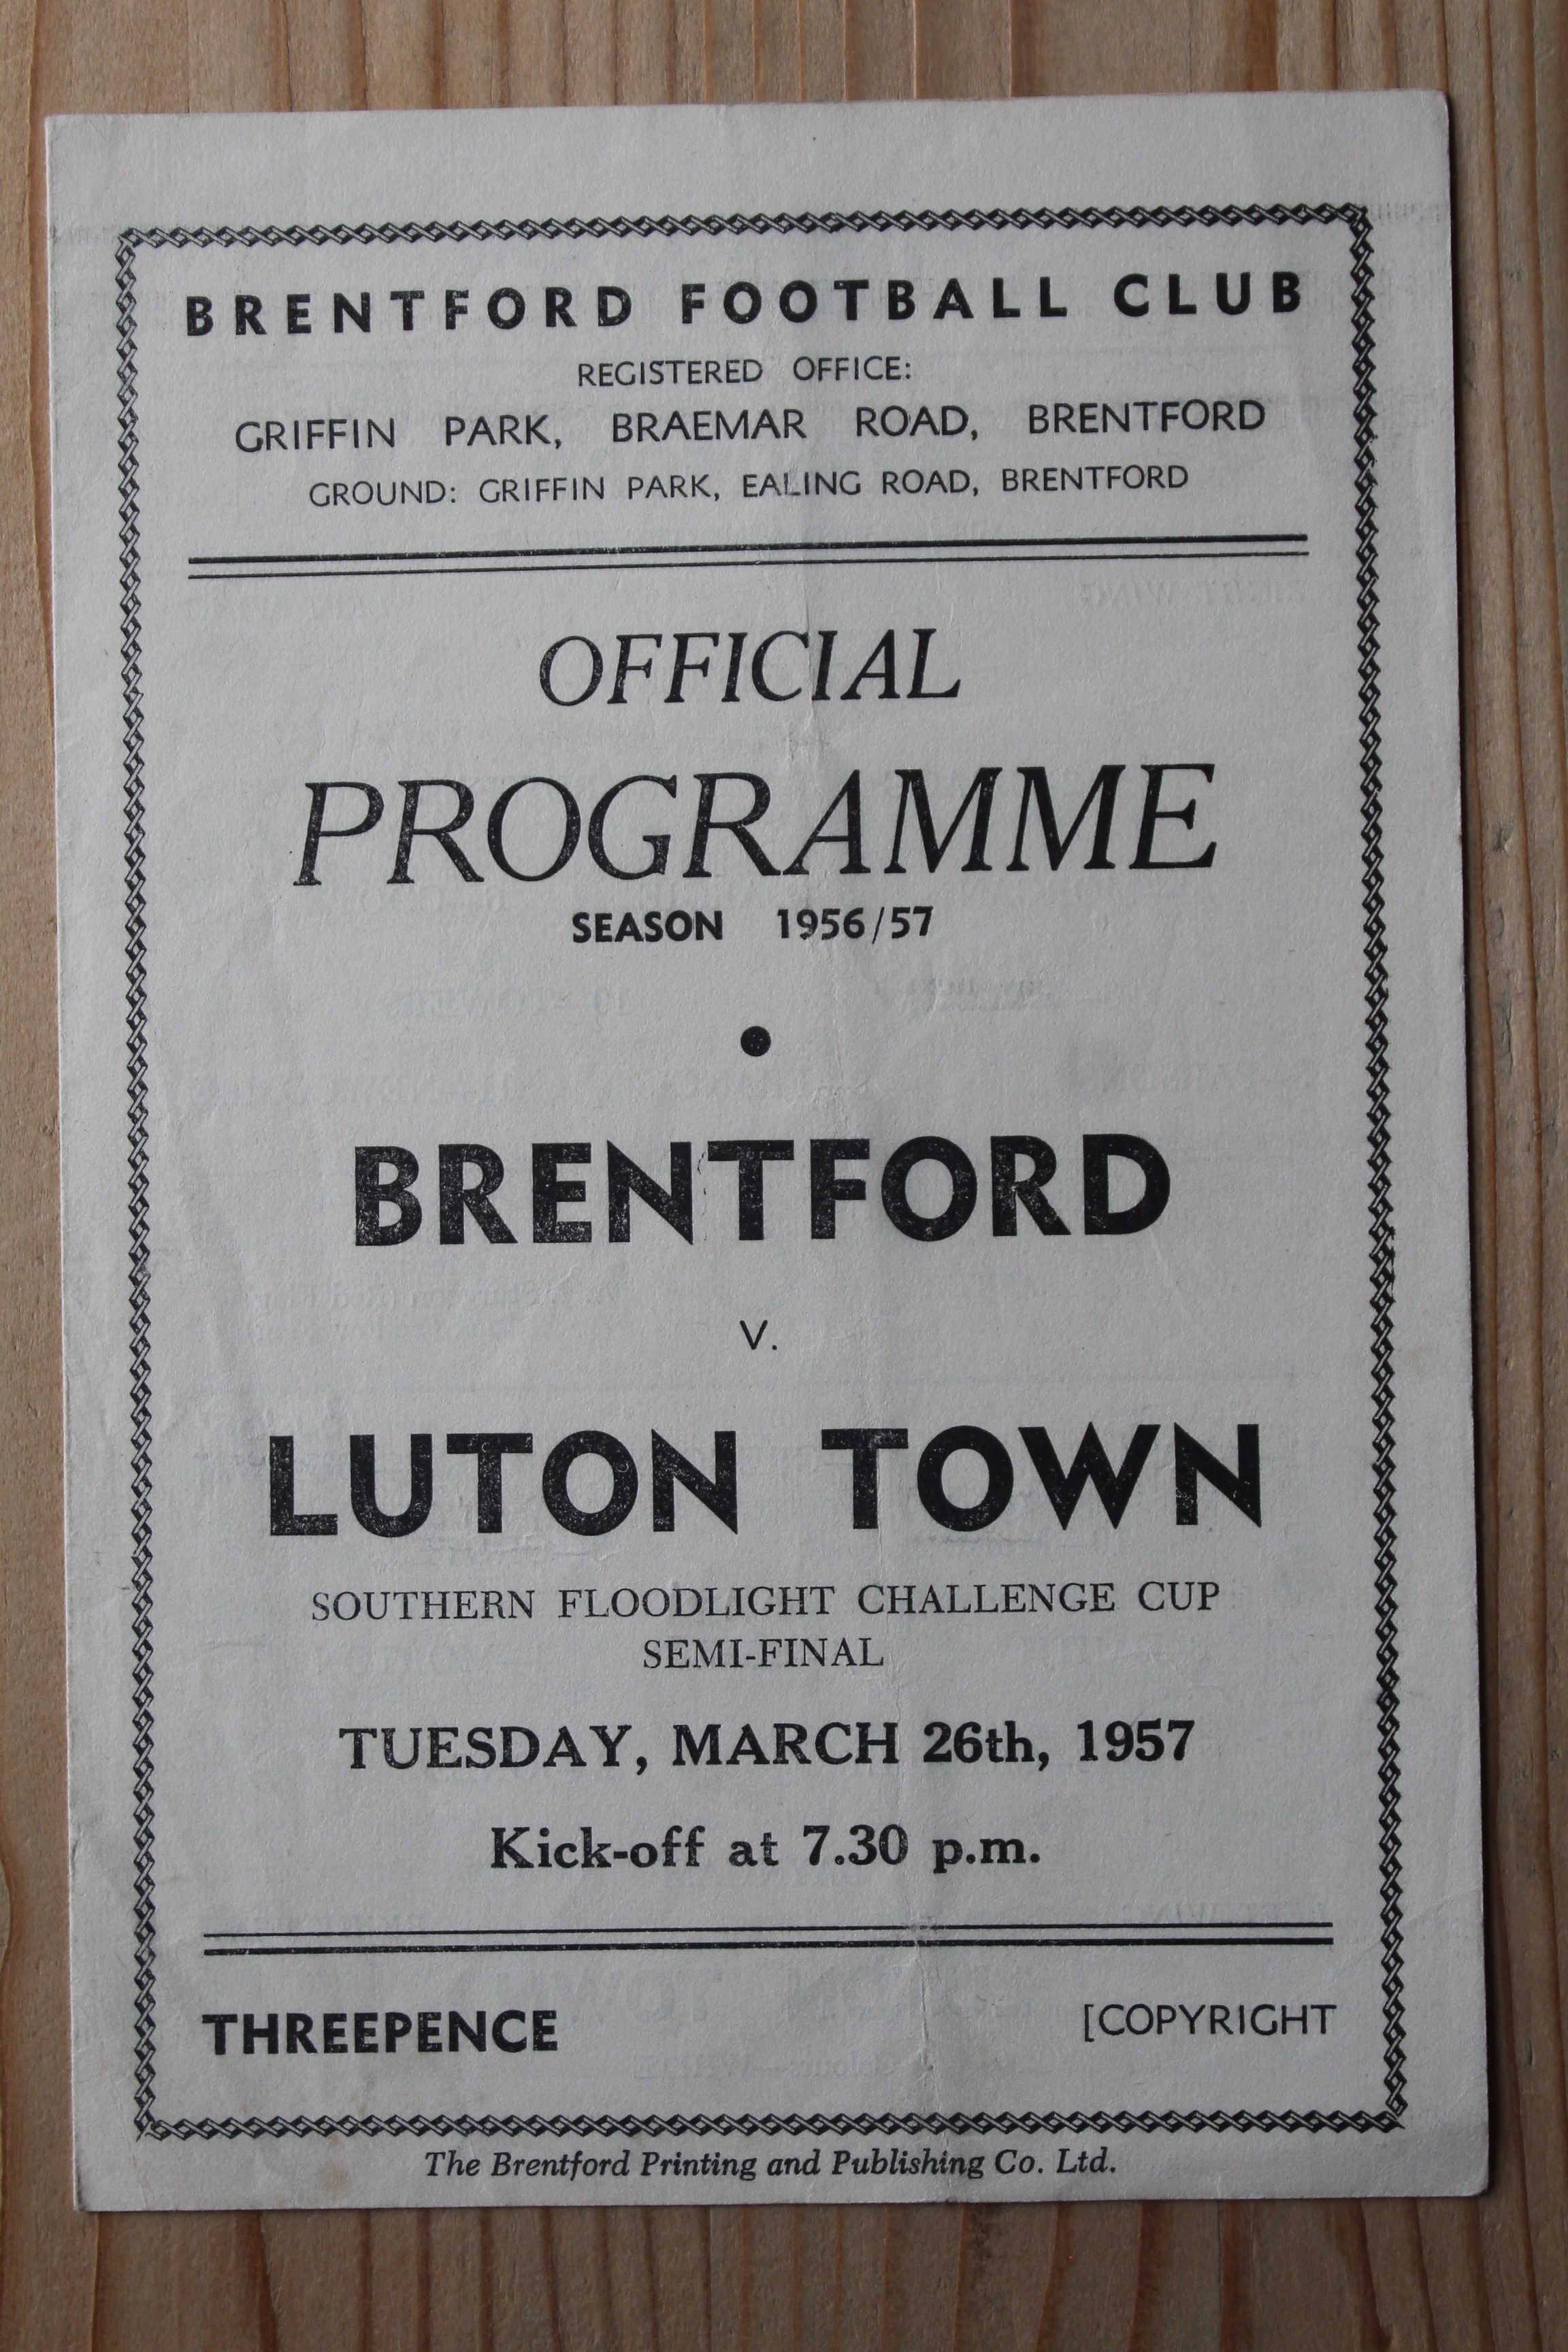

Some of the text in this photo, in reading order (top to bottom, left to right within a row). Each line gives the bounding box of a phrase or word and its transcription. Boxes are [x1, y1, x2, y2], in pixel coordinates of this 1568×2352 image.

[186, 271, 1301, 336] BRENTFORD FOOTBALL CLUB
[578, 356, 911, 387] REGISTERED OFFICE:
[235, 399, 1265, 453] GRIFFIN PARK, BRAEMAR ROAD, BRENTFORD
[310, 465, 1188, 507] GROUND: GRIFFIN PARK, EALING ROAD, BRENTFORD
[540, 628, 961, 706] OFFICIAL
[293, 764, 1217, 886] PROGRAMME
[572, 906, 933, 945] SEASON 1956/57
[355, 1134, 1171, 1246] BRENTFORD
[269, 1422, 1262, 1538] LUTON TOWN
[312, 1581, 1220, 1620] SOUTHERN FLOODLIGHT CHALLENGE CUP
[644, 1637, 883, 1669] SEMI-FINAL
[339, 1718, 1194, 1776] TUESDAY, MARCH 26th, 1957
[491, 1824, 1040, 1874] Kick-off at 7.30 p.m.
[202, 2010, 557, 2055] THREEPENCE
[425, 2146, 1115, 2180] The Brentford Printing and Publishing Co. Ltd.
